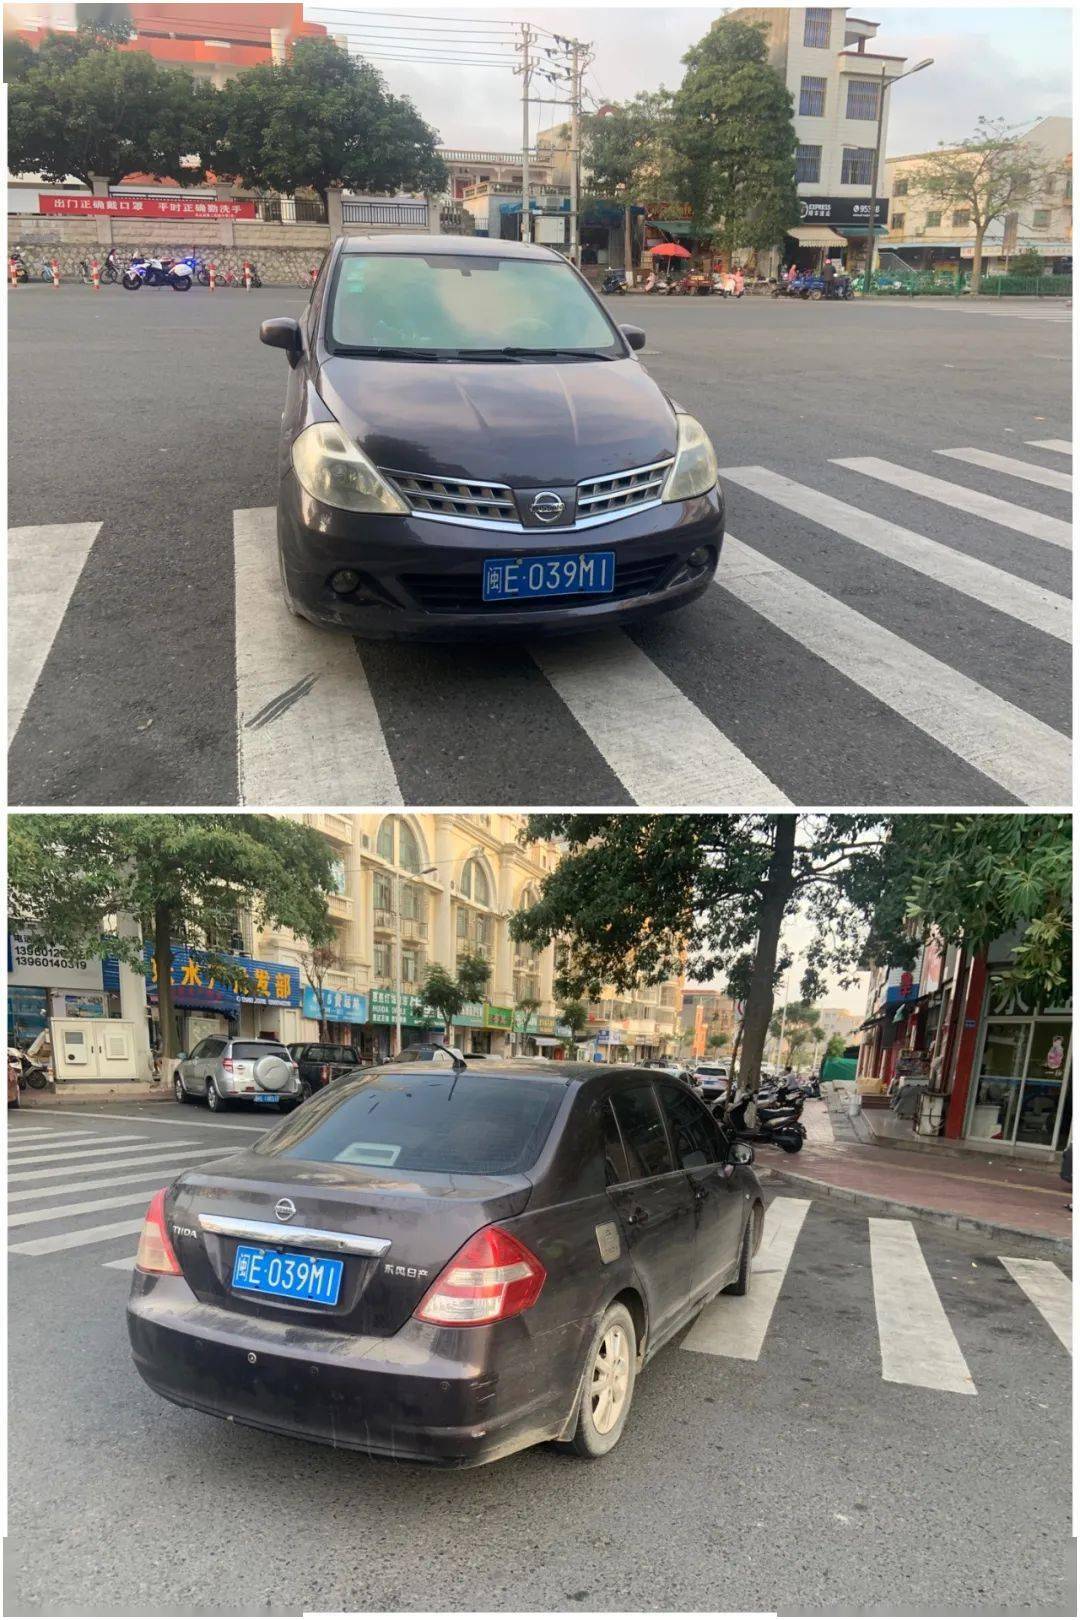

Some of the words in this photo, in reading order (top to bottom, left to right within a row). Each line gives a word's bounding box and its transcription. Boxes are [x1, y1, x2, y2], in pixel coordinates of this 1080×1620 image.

[54, 199, 143, 211] 出门正确戴口罩
[158, 203, 242, 214] 平时正确勤洗手
[15, 956, 87, 970] 13960140319
[384, 1263, 429, 1279] 东风日产
